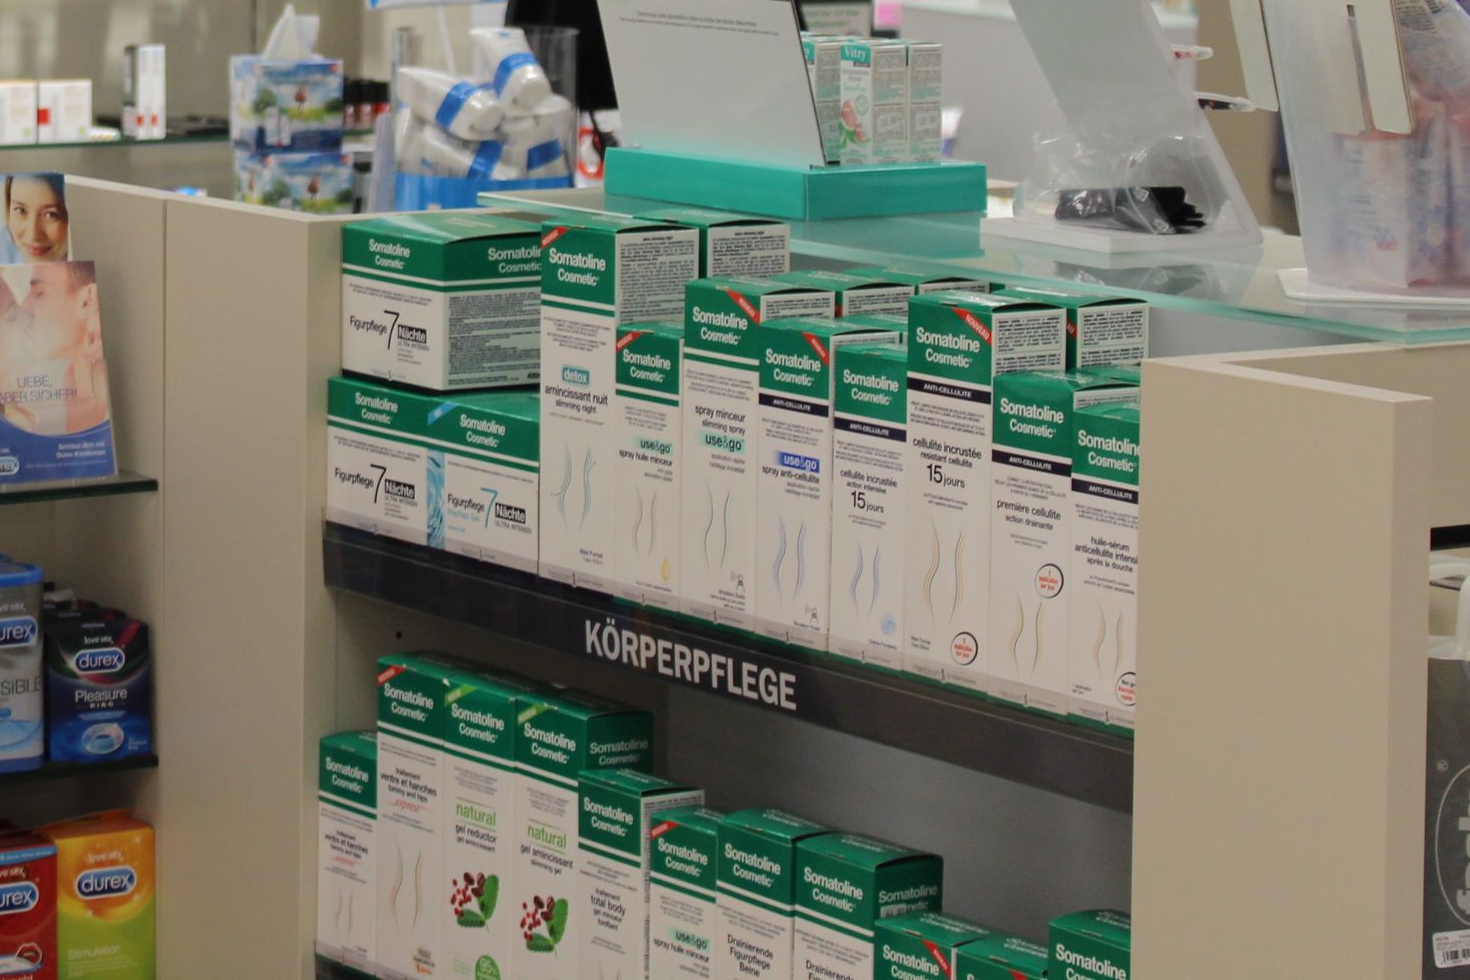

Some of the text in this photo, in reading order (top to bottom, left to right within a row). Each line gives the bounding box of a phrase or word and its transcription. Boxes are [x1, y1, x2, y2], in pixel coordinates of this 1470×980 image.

[845, 45, 866, 62] Vitry
[549, 248, 606, 270] Somatoline
[349, 310, 426, 350] Figurpflege 7 Nächte
[693, 307, 748, 330] Somatoline
[916, 327, 980, 353] Somatoline
[766, 348, 821, 372] Somatoline
[17, 375, 53, 389] LIEBE,
[564, 370, 588, 383] detox
[843, 370, 899, 392] Somatoline
[545, 385, 608, 404] amincissant nuit
[852, 388, 891, 405] Cosmetic
[695, 405, 745, 422] spray minceur
[1000, 398, 1064, 424] Somatoline
[1009, 420, 1054, 438] Cosmetic
[913, 437, 982, 460] cellulite incrustée
[335, 464, 415, 504] Figurpflege 7 Nächte
[840, 469, 862, 480] cellulite
[927, 464, 965, 489] 15 jours
[448, 494, 485, 512] Figurpflege
[481, 488, 498, 528] 7
[495, 503, 525, 523] Nächte
[851, 491, 884, 513] 15 jours
[997, 499, 1061, 521] première cellulite
[10, 603, 26, 612] sex
[80, 652, 119, 668] durex
[585, 617, 797, 711] KÖRPERPFLEGE
[75, 689, 128, 703] Pleasure
[384, 683, 434, 710] Somatoline
[451, 704, 504, 731] Somatoline
[459, 723, 496, 743] Cosmetic
[524, 724, 576, 752] Somatoline
[531, 743, 567, 764] Cosmetic
[456, 801, 496, 827] natural
[584, 797, 634, 825] Somatoline
[455, 823, 497, 844] gel reductor
[527, 823, 567, 849] natural
[87, 851, 124, 862] love sex
[521, 843, 573, 868] gel amincissant
[658, 837, 708, 865] Somatoline
[725, 843, 781, 875] Somatoline
[81, 874, 131, 893] durex
[733, 864, 772, 888] Cosmetic
[804, 867, 863, 900] Somatoline
[591, 895, 626, 916] total body
[813, 889, 854, 913] Cosmetic
[727, 934, 774, 960] Drainierende
[730, 947, 771, 971] Figurpflege
[739, 962, 761, 978] Beine
[883, 945, 939, 976] Somatoline
[1056, 943, 1126, 980] Somatoline
